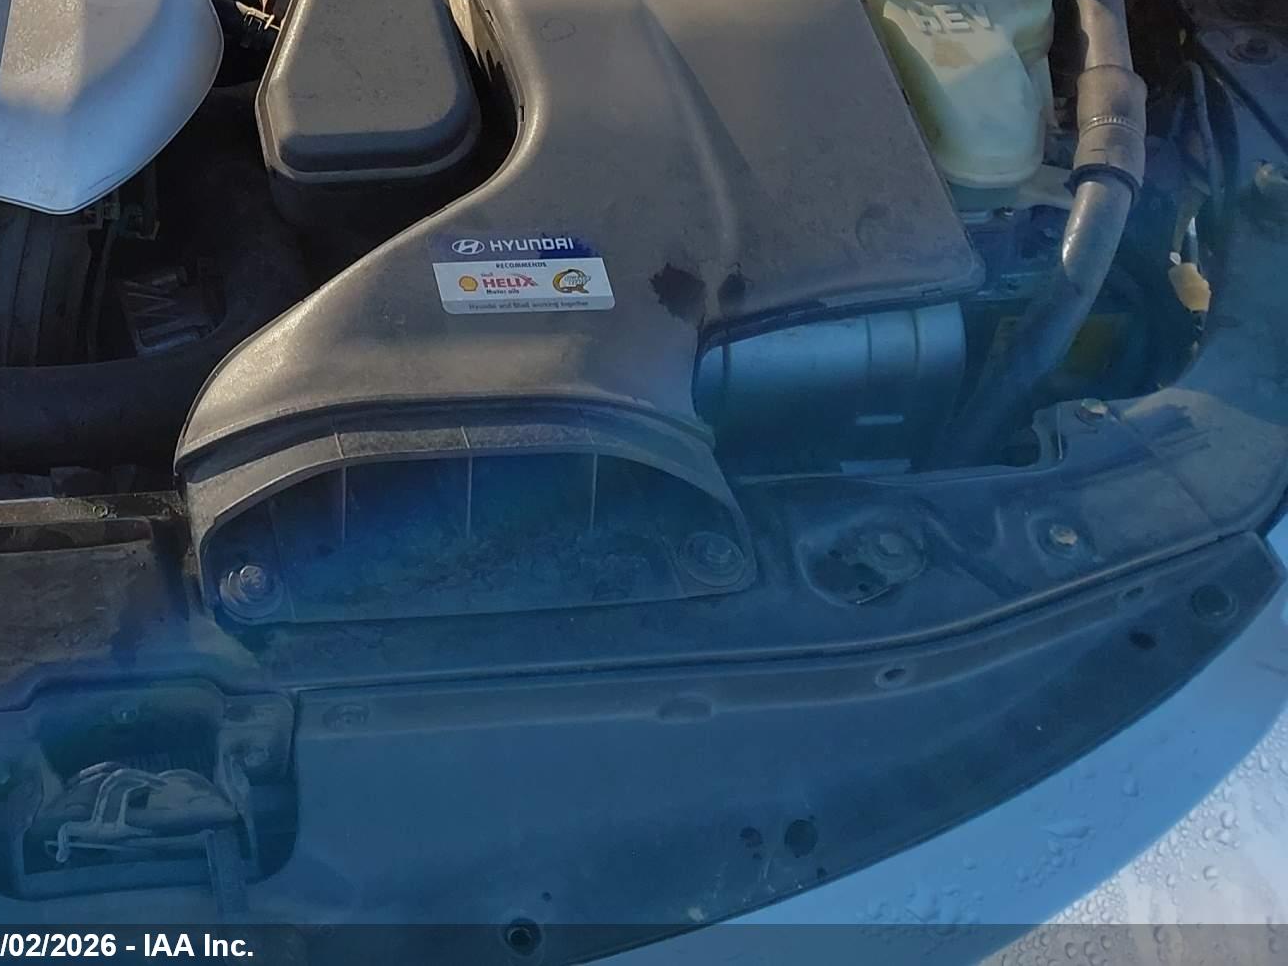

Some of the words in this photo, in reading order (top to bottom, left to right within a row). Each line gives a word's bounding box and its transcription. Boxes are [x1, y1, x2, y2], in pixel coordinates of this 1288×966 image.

[906, 1, 995, 36] HEV
[489, 237, 575, 252] HYUNDAI
[482, 275, 538, 289] HELIX
